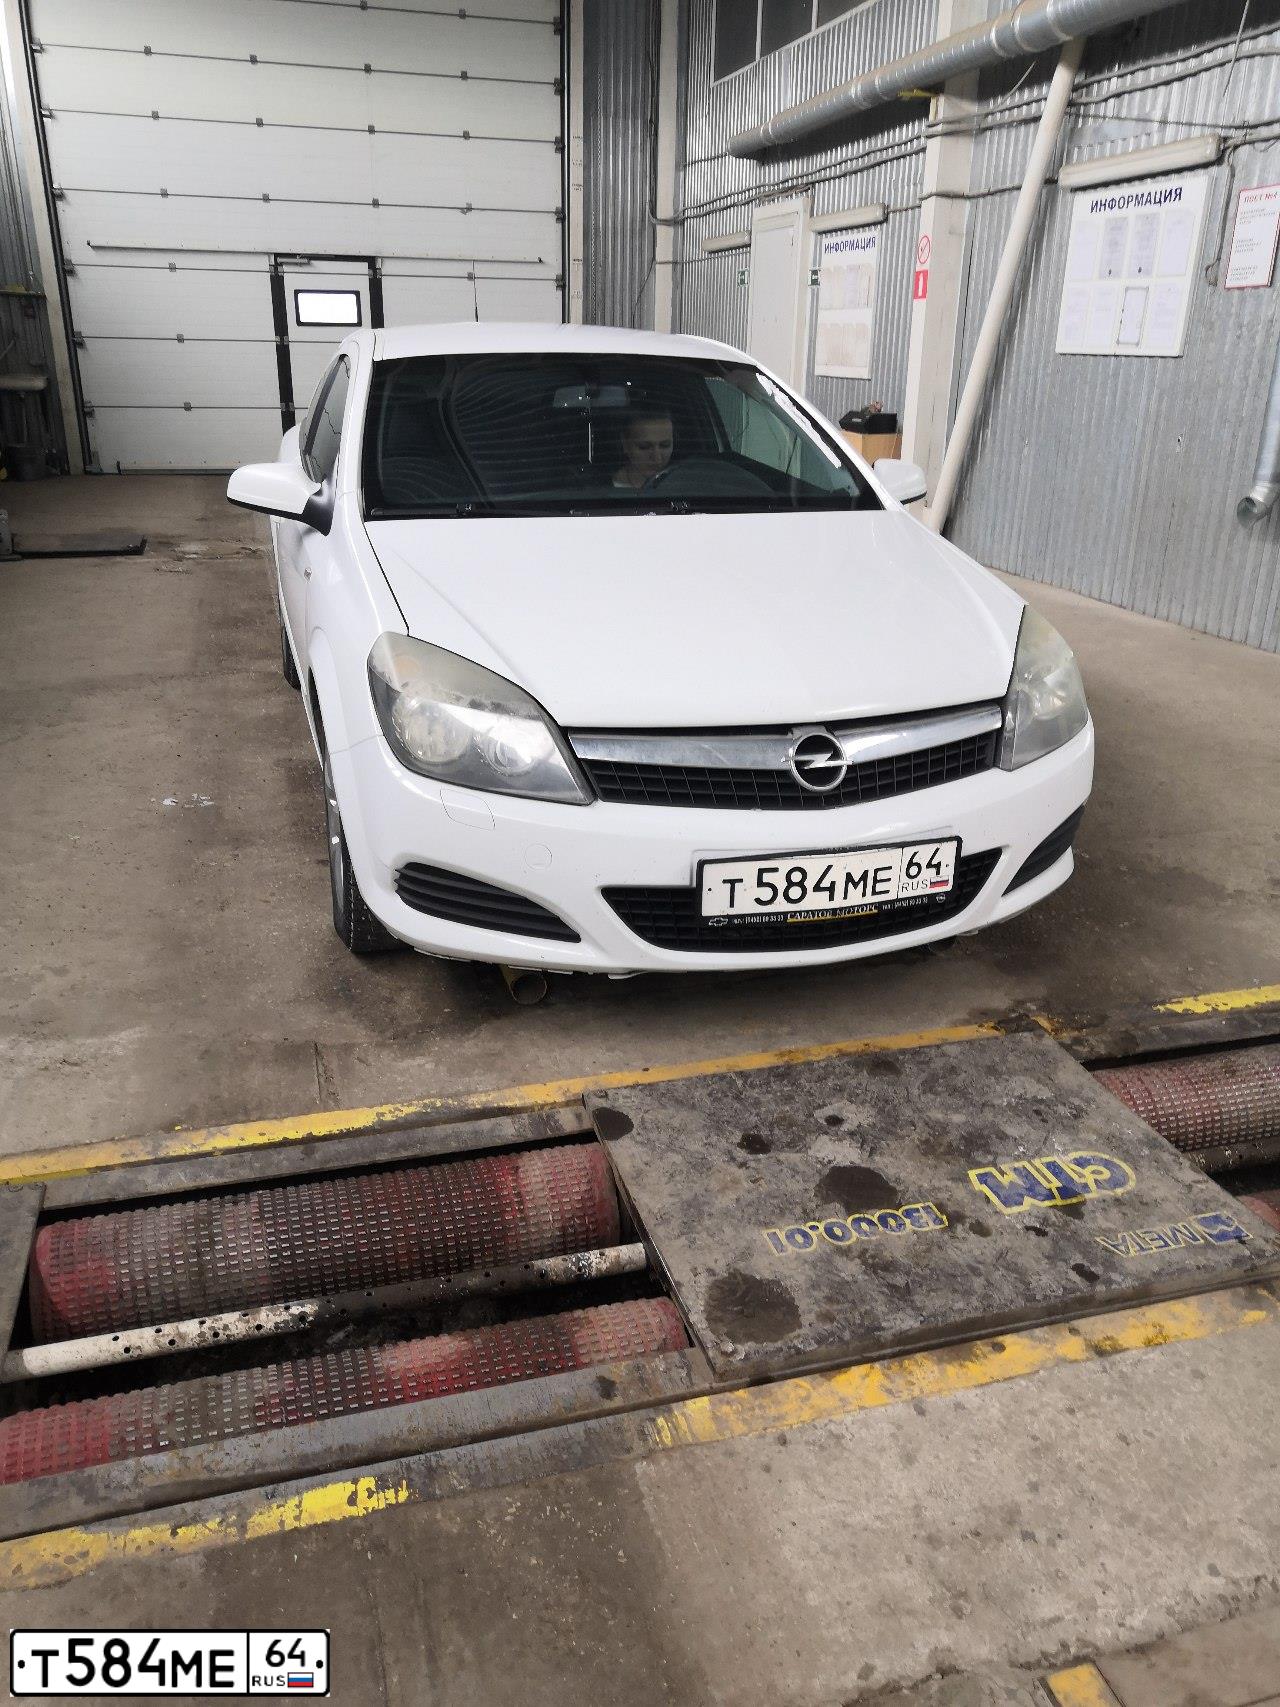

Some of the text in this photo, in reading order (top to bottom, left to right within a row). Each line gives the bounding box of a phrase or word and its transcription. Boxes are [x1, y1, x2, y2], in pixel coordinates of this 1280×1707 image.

[1090, 186, 1183, 214] ИНФОРМАЦИЯ
[824, 236, 876, 254] ИНФОРМАЦИЯ
[905, 847, 942, 879] 64
[901, 879, 929, 893] RUS
[764, 1201, 948, 1256] 13000.01
